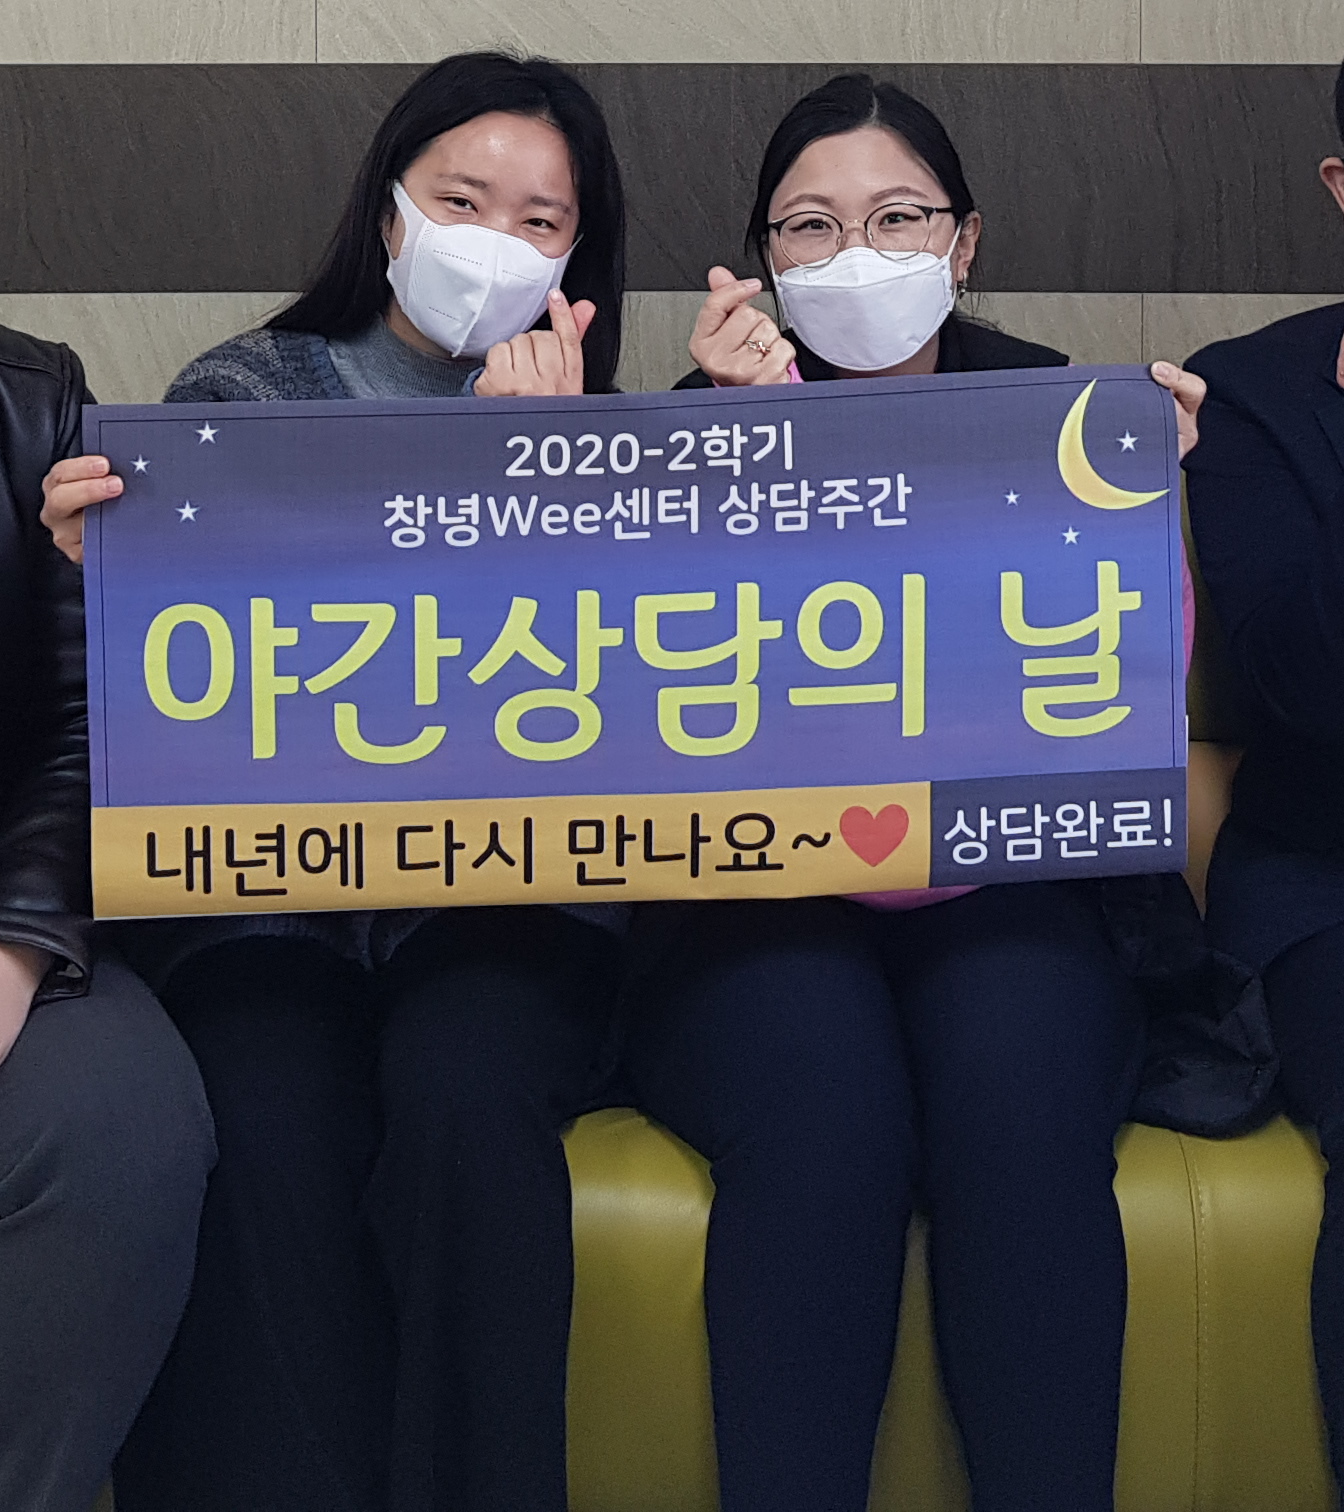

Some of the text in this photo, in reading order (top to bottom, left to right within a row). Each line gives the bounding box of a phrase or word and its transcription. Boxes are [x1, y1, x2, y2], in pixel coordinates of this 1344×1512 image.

[504, 420, 794, 479] 2020-2학기
[383, 473, 913, 549] 창녕Wee센터 상담주간
[142, 560, 1143, 765] 야간상담의 날
[145, 821, 364, 897] 내년에
[396, 816, 533, 887] 다시
[943, 798, 1173, 865] 상담완료!
